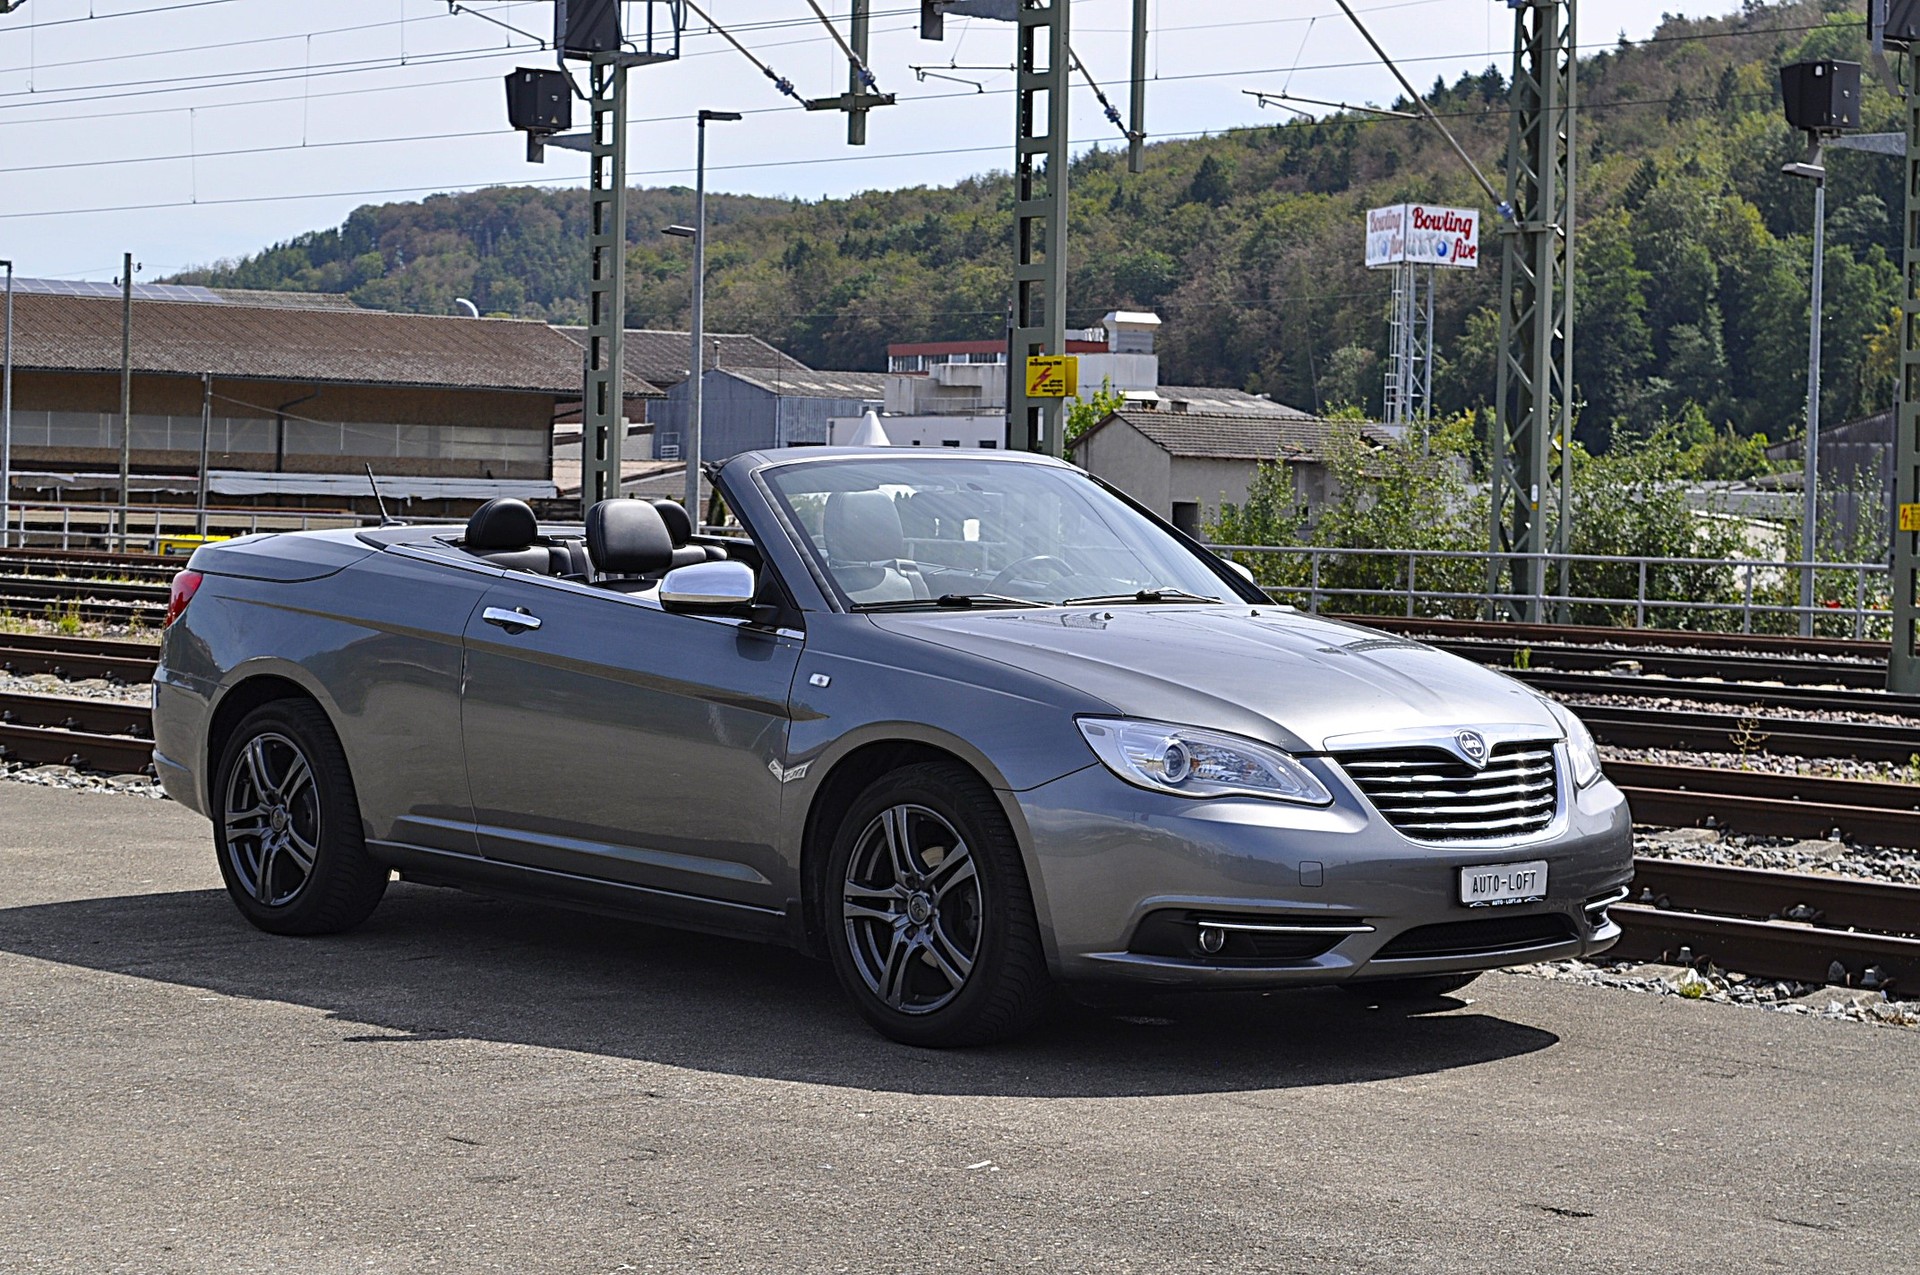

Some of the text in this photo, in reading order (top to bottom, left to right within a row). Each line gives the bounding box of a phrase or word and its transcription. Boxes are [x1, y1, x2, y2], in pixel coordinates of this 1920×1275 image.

[1369, 209, 1402, 235] Bowling
[1412, 206, 1473, 240] Bowling
[1450, 237, 1477, 263] five
[1472, 870, 1537, 894] AUTO-LOFT
